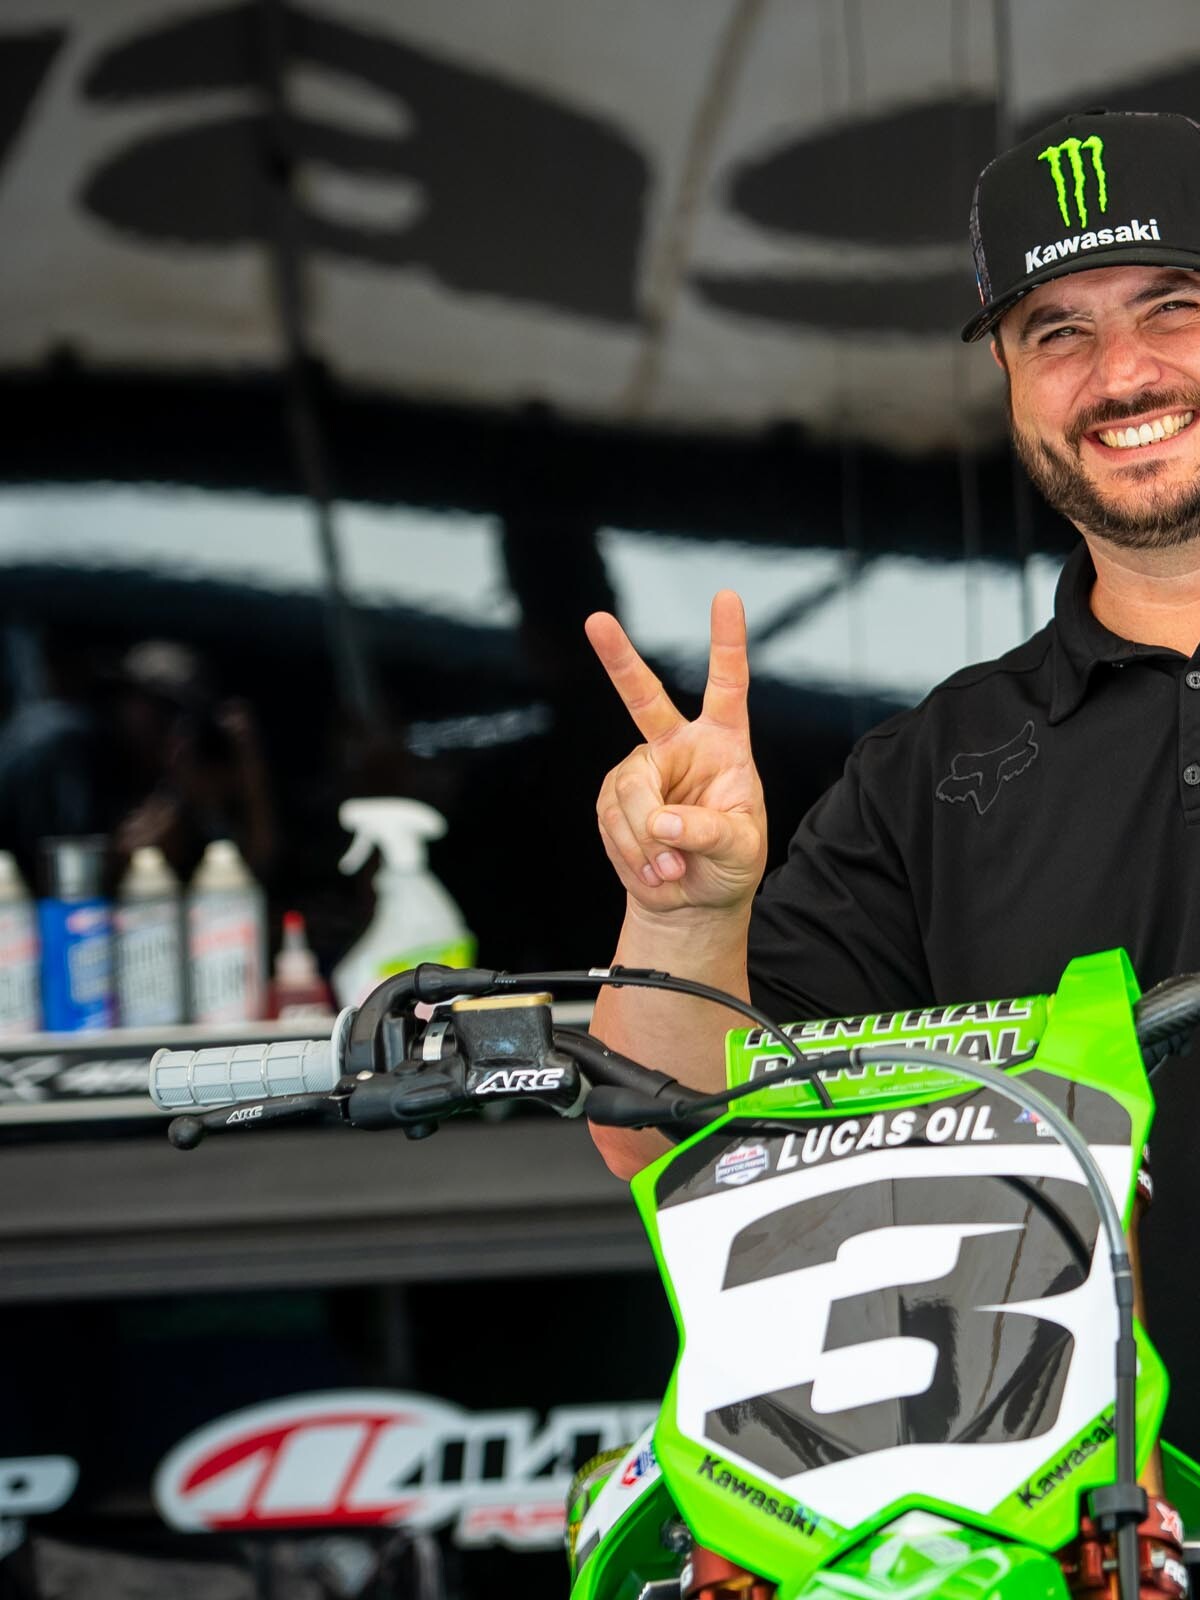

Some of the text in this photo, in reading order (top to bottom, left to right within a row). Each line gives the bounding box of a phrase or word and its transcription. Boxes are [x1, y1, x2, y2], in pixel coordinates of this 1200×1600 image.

[1025, 219, 1161, 273] Kawasaki
[475, 1067, 564, 1094] ARC
[226, 1105, 264, 1124] ARC
[776, 1111, 917, 1171] LUCAS
[926, 1105, 996, 1142] OIL
[703, 1175, 1101, 1480] 3
[1017, 1414, 1116, 1510] Kawasak
[697, 1454, 820, 1537] Kawasaki
